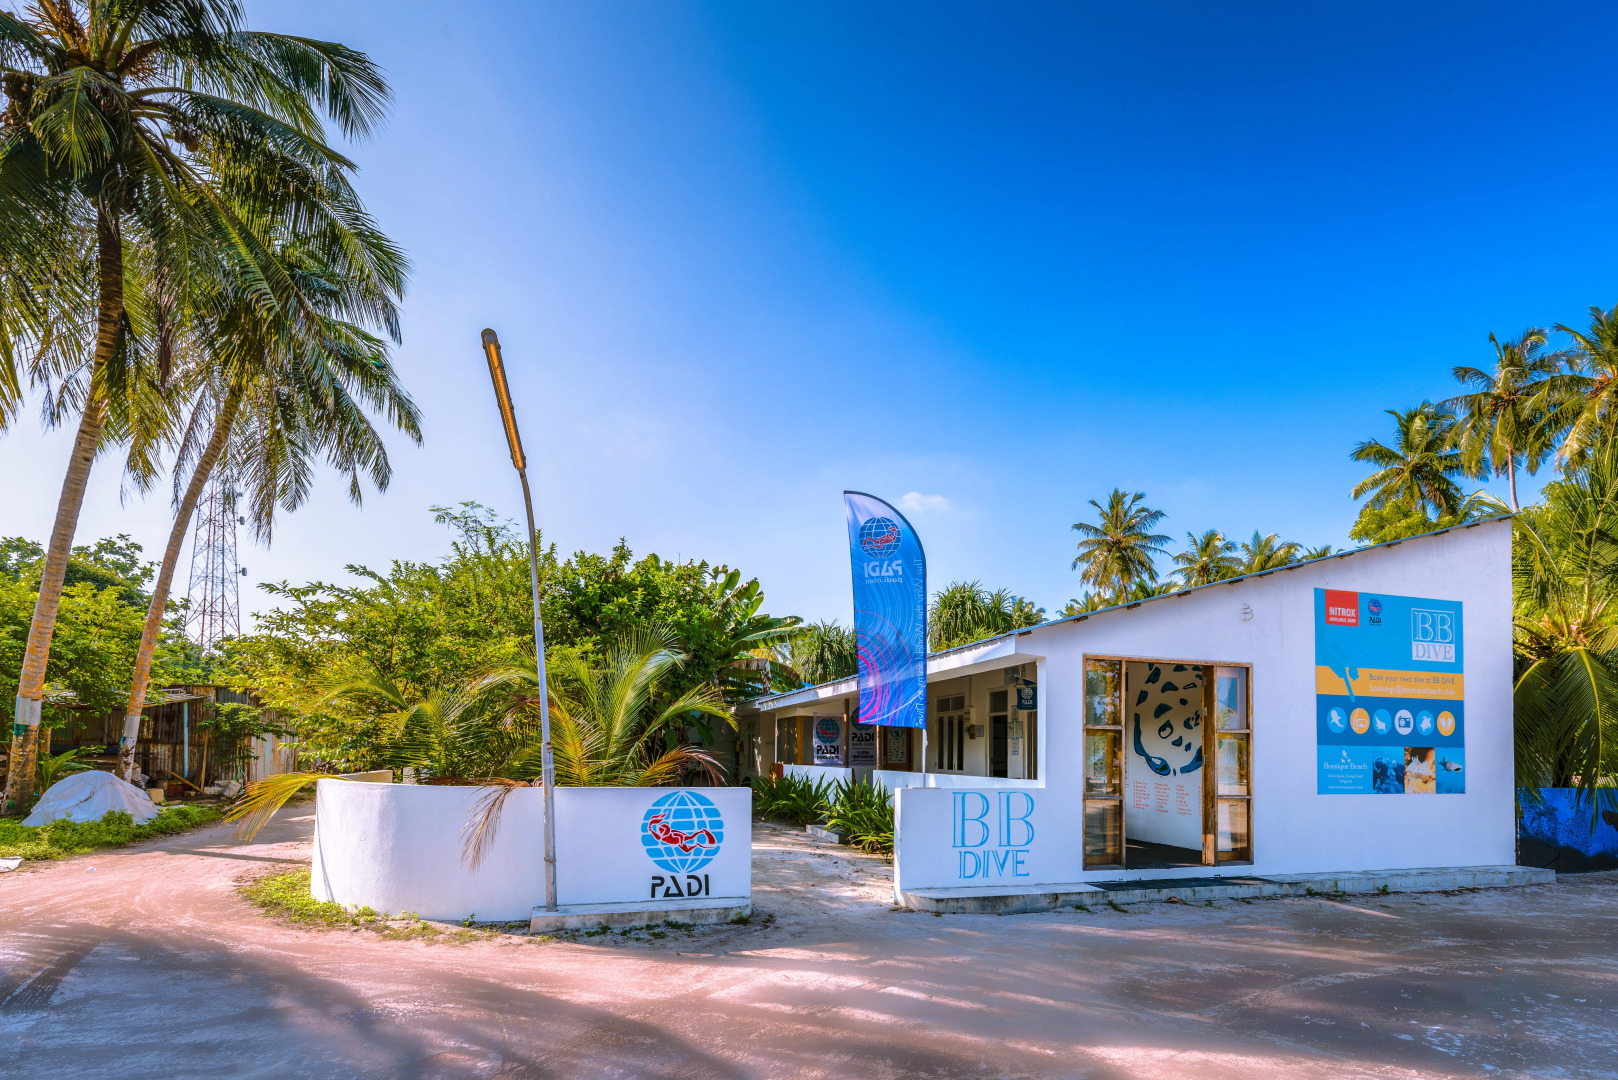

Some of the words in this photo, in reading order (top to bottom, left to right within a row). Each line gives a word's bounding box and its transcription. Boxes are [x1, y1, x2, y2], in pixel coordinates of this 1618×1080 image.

[1329, 607, 1356, 617] NITROX
[1368, 616, 1382, 624] PADI
[1414, 611, 1453, 642] BB
[1414, 643, 1453, 660] DIVE
[1369, 673, 1384, 681] Book
[851, 732, 874, 742] PADI
[816, 745, 839, 755] PADI
[1323, 762, 1349, 771] Boutique
[1350, 762, 1368, 770] Beach
[952, 791, 1035, 848] BB
[958, 850, 1030, 879] DIVE
[650, 874, 710, 898] PADI
